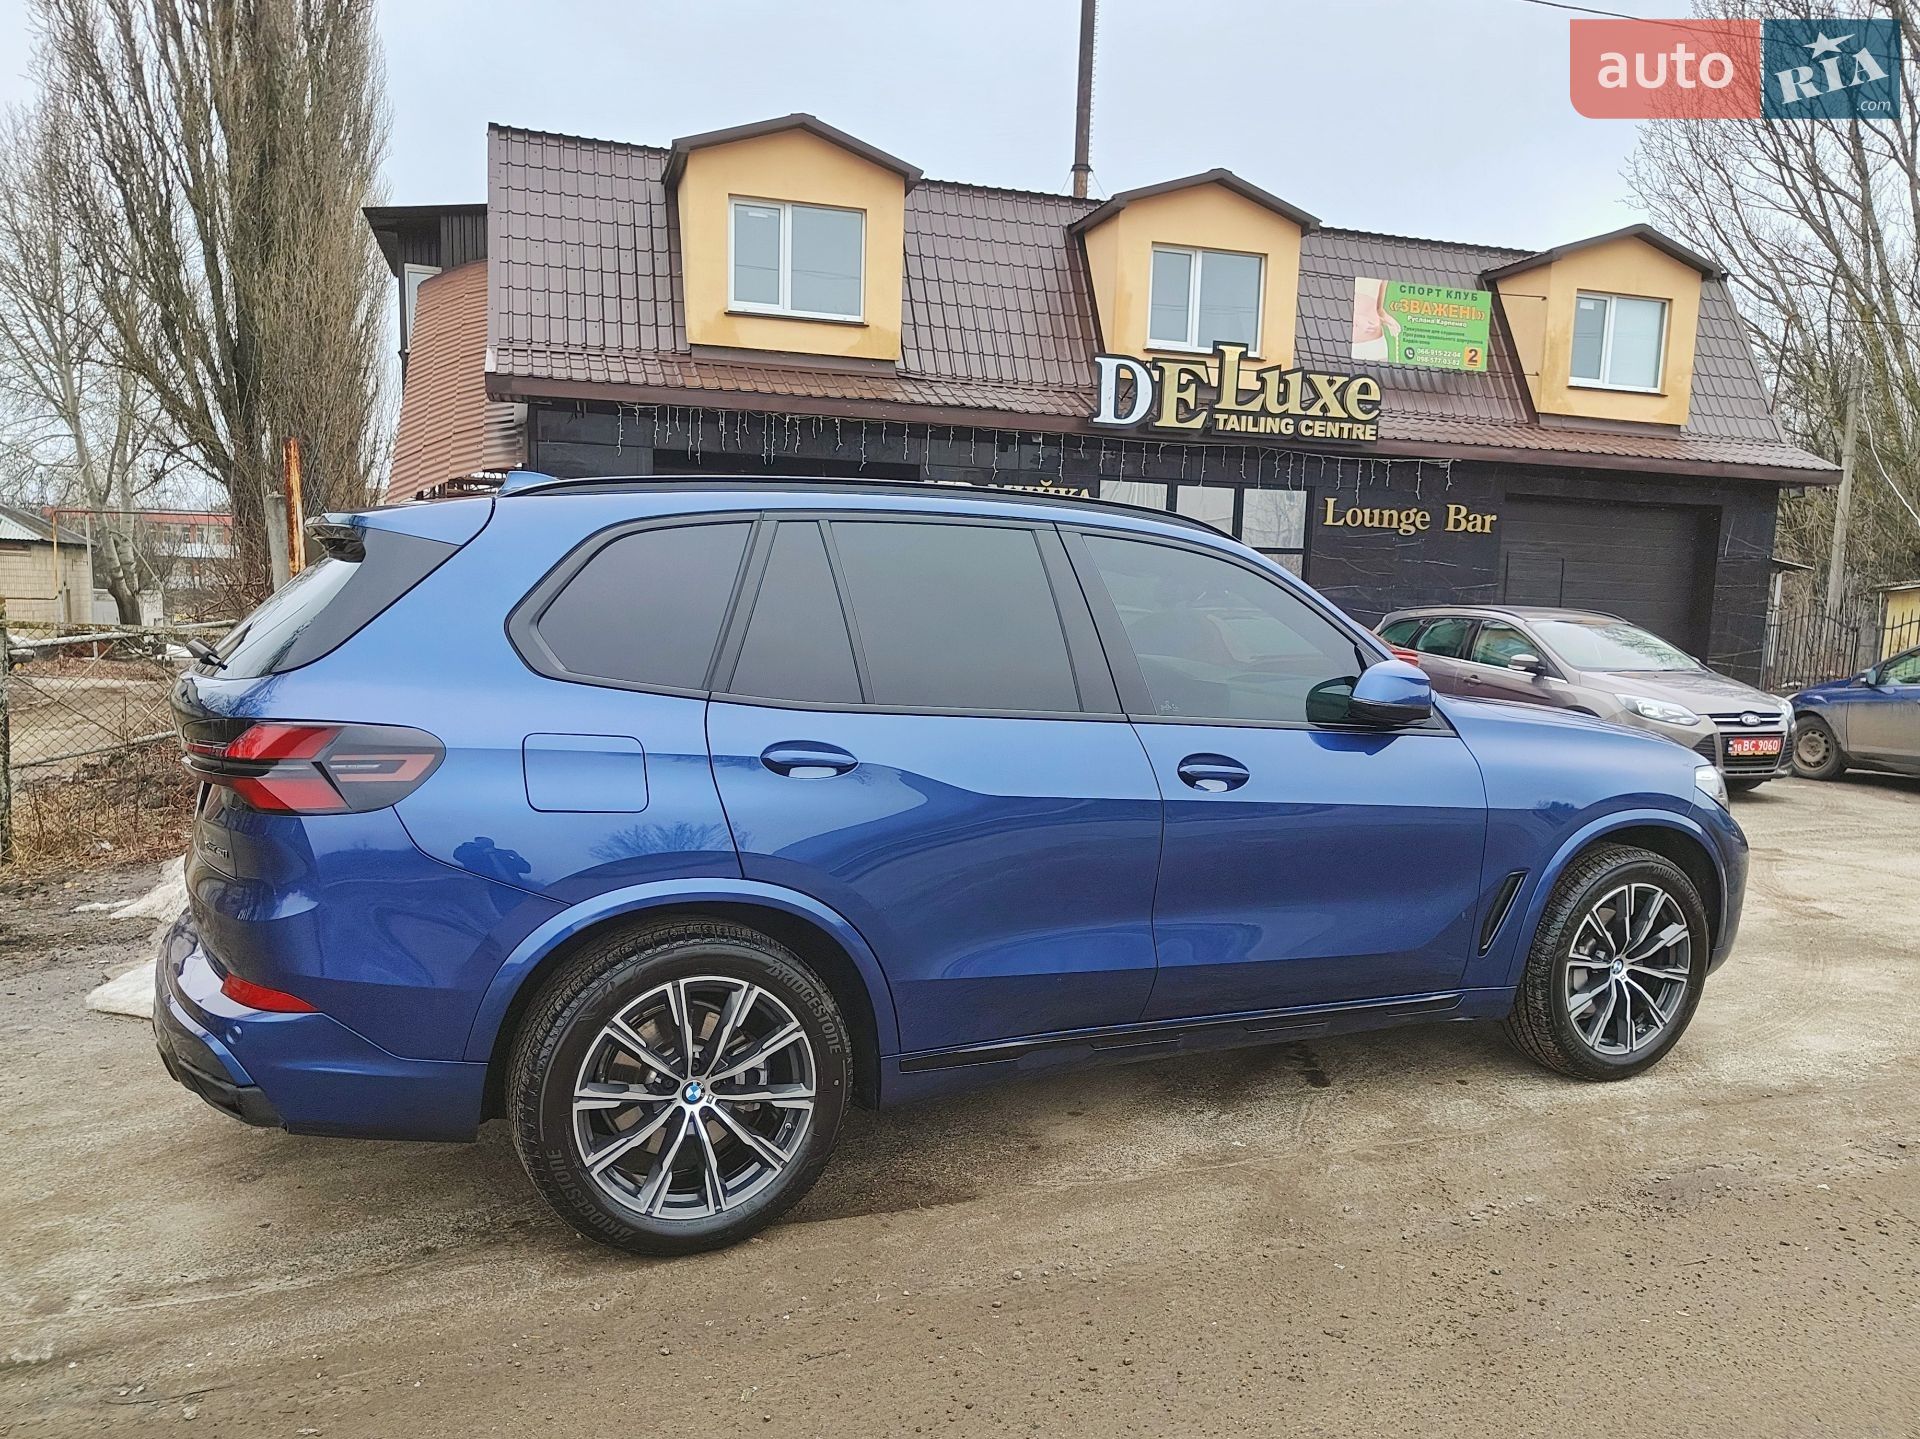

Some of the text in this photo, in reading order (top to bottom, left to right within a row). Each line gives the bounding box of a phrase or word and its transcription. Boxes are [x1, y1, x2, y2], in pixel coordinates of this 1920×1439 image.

[1400, 284, 1478, 301] СПОРТ КЛУБ
[1467, 348, 1479, 364] 2
[1215, 413, 1378, 441] TAILING CENTRE
[1323, 497, 1498, 536] Lounge Bar
[1743, 739, 1756, 751] BC
[1758, 739, 1778, 751] 9060
[764, 959, 842, 1055] BRIDGESTONE
